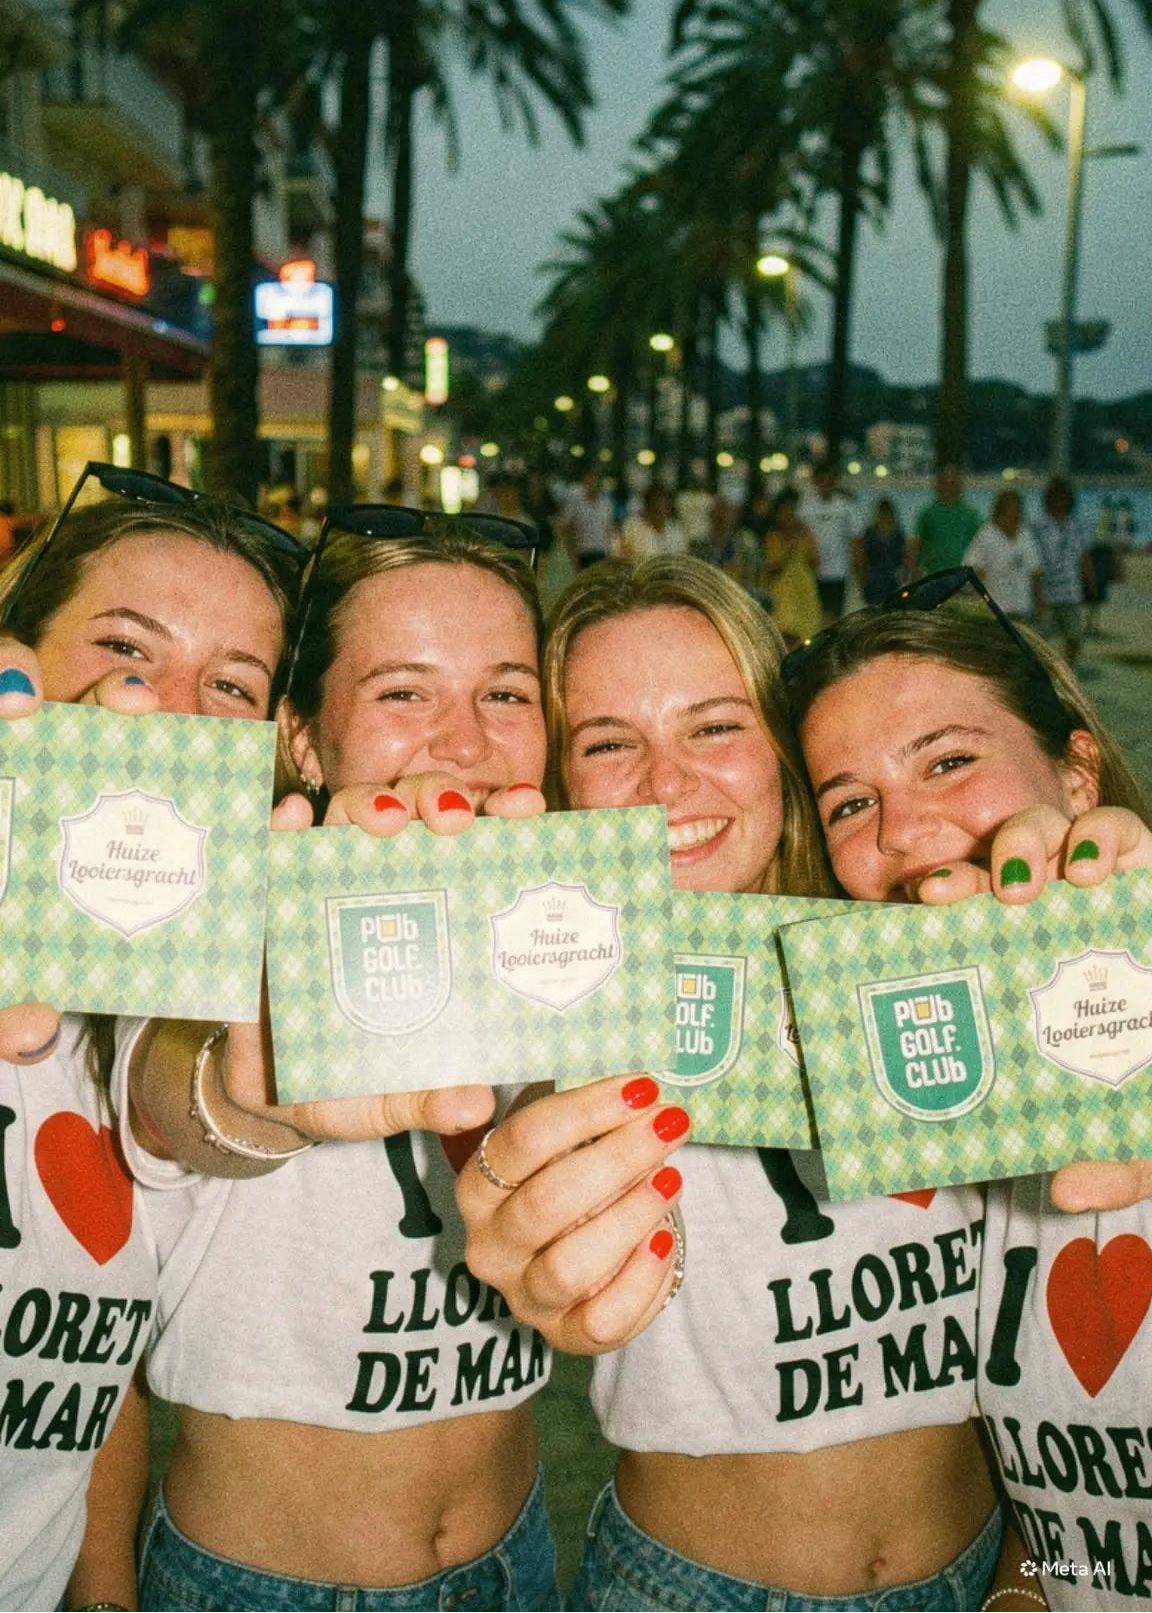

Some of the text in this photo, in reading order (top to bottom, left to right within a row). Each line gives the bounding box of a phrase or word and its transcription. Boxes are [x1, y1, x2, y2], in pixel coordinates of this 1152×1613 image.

[107, 840, 161, 862] Huize
[68, 859, 197, 888] Looiersgracht
[530, 928, 580, 947] Huize
[498, 943, 614, 973] Looiersgracht
[676, 1003, 715, 1028] OLF.
[1073, 997, 1128, 1018] Huize
[675, 1029, 714, 1055] LUb
[0, 1285, 152, 1366] ORET
[986, 1246, 1038, 1387] I
[345, 1348, 439, 1413] DE
[775, 1314, 978, 1422] DE MA
[985, 1414, 1152, 1500] LLORE
